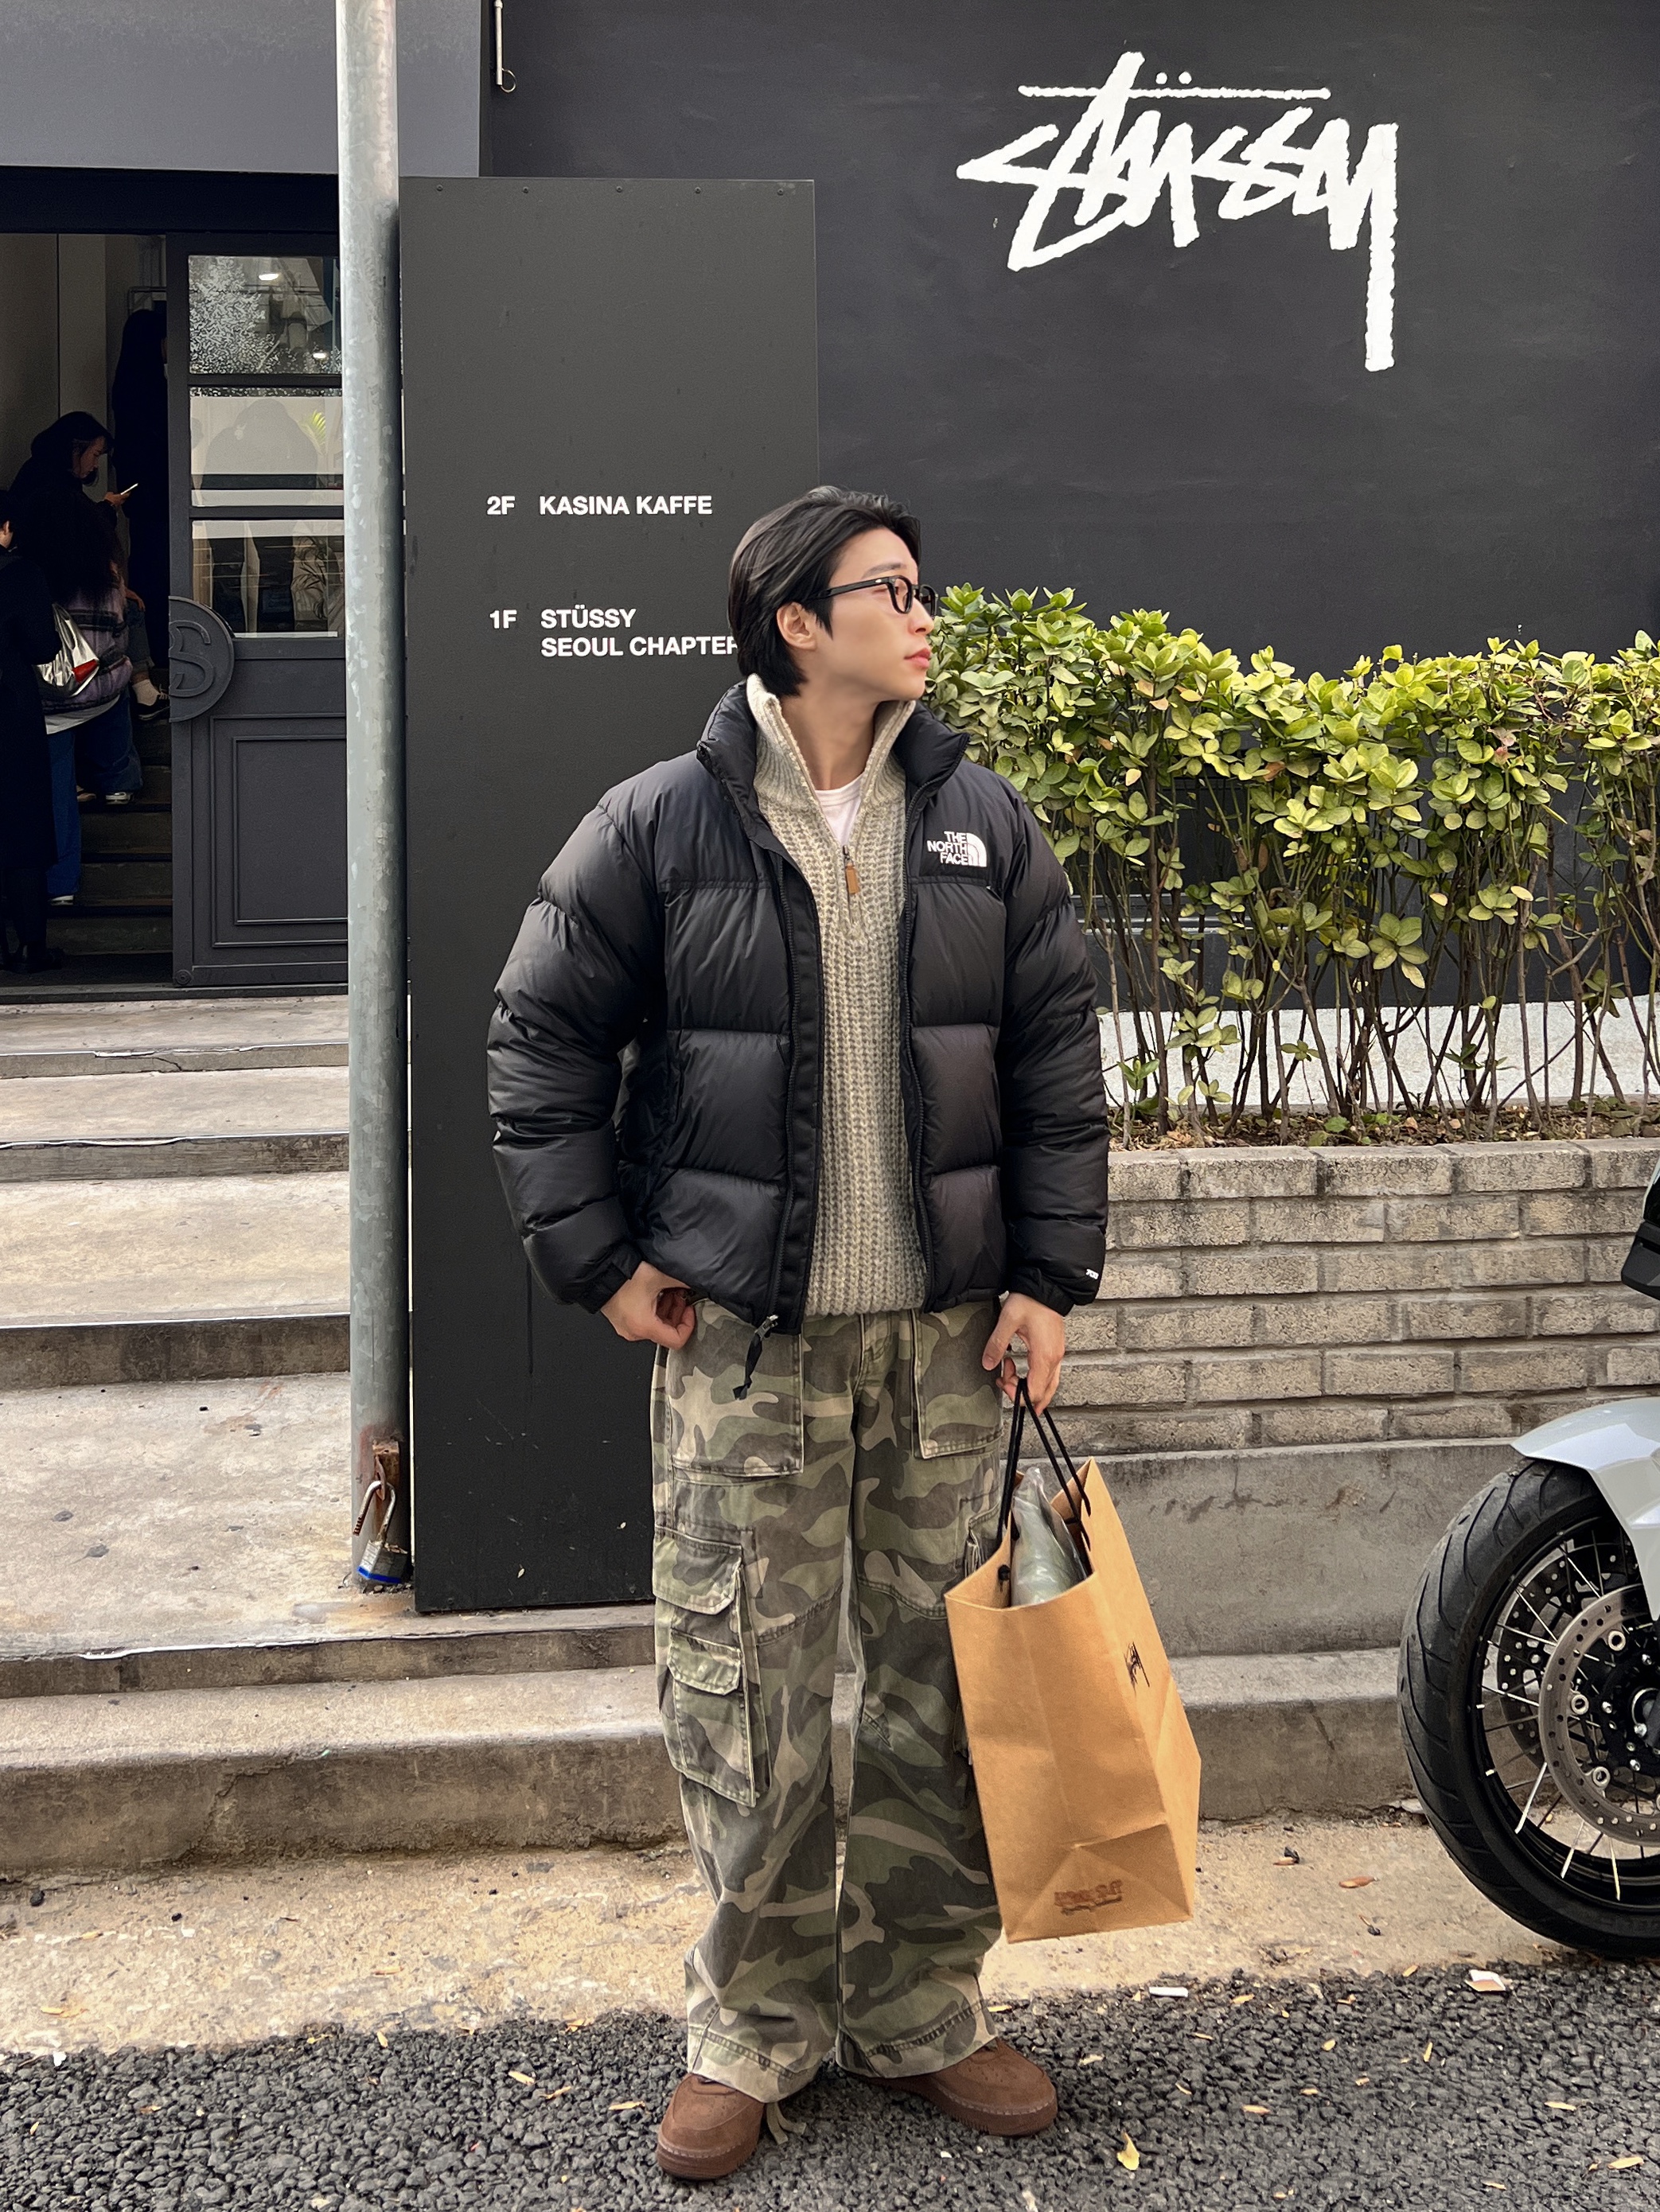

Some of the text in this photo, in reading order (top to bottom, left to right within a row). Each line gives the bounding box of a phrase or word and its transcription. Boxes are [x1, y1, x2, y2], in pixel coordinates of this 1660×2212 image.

[486, 495, 713, 516] 2F KASINA KAFFE
[489, 604, 637, 629] 1F STÜSSY
[540, 637, 624, 657] SEOUL
[944, 831, 967, 843] THE
[926, 839, 968, 855] NORTH
[940, 851, 968, 865] FACE
